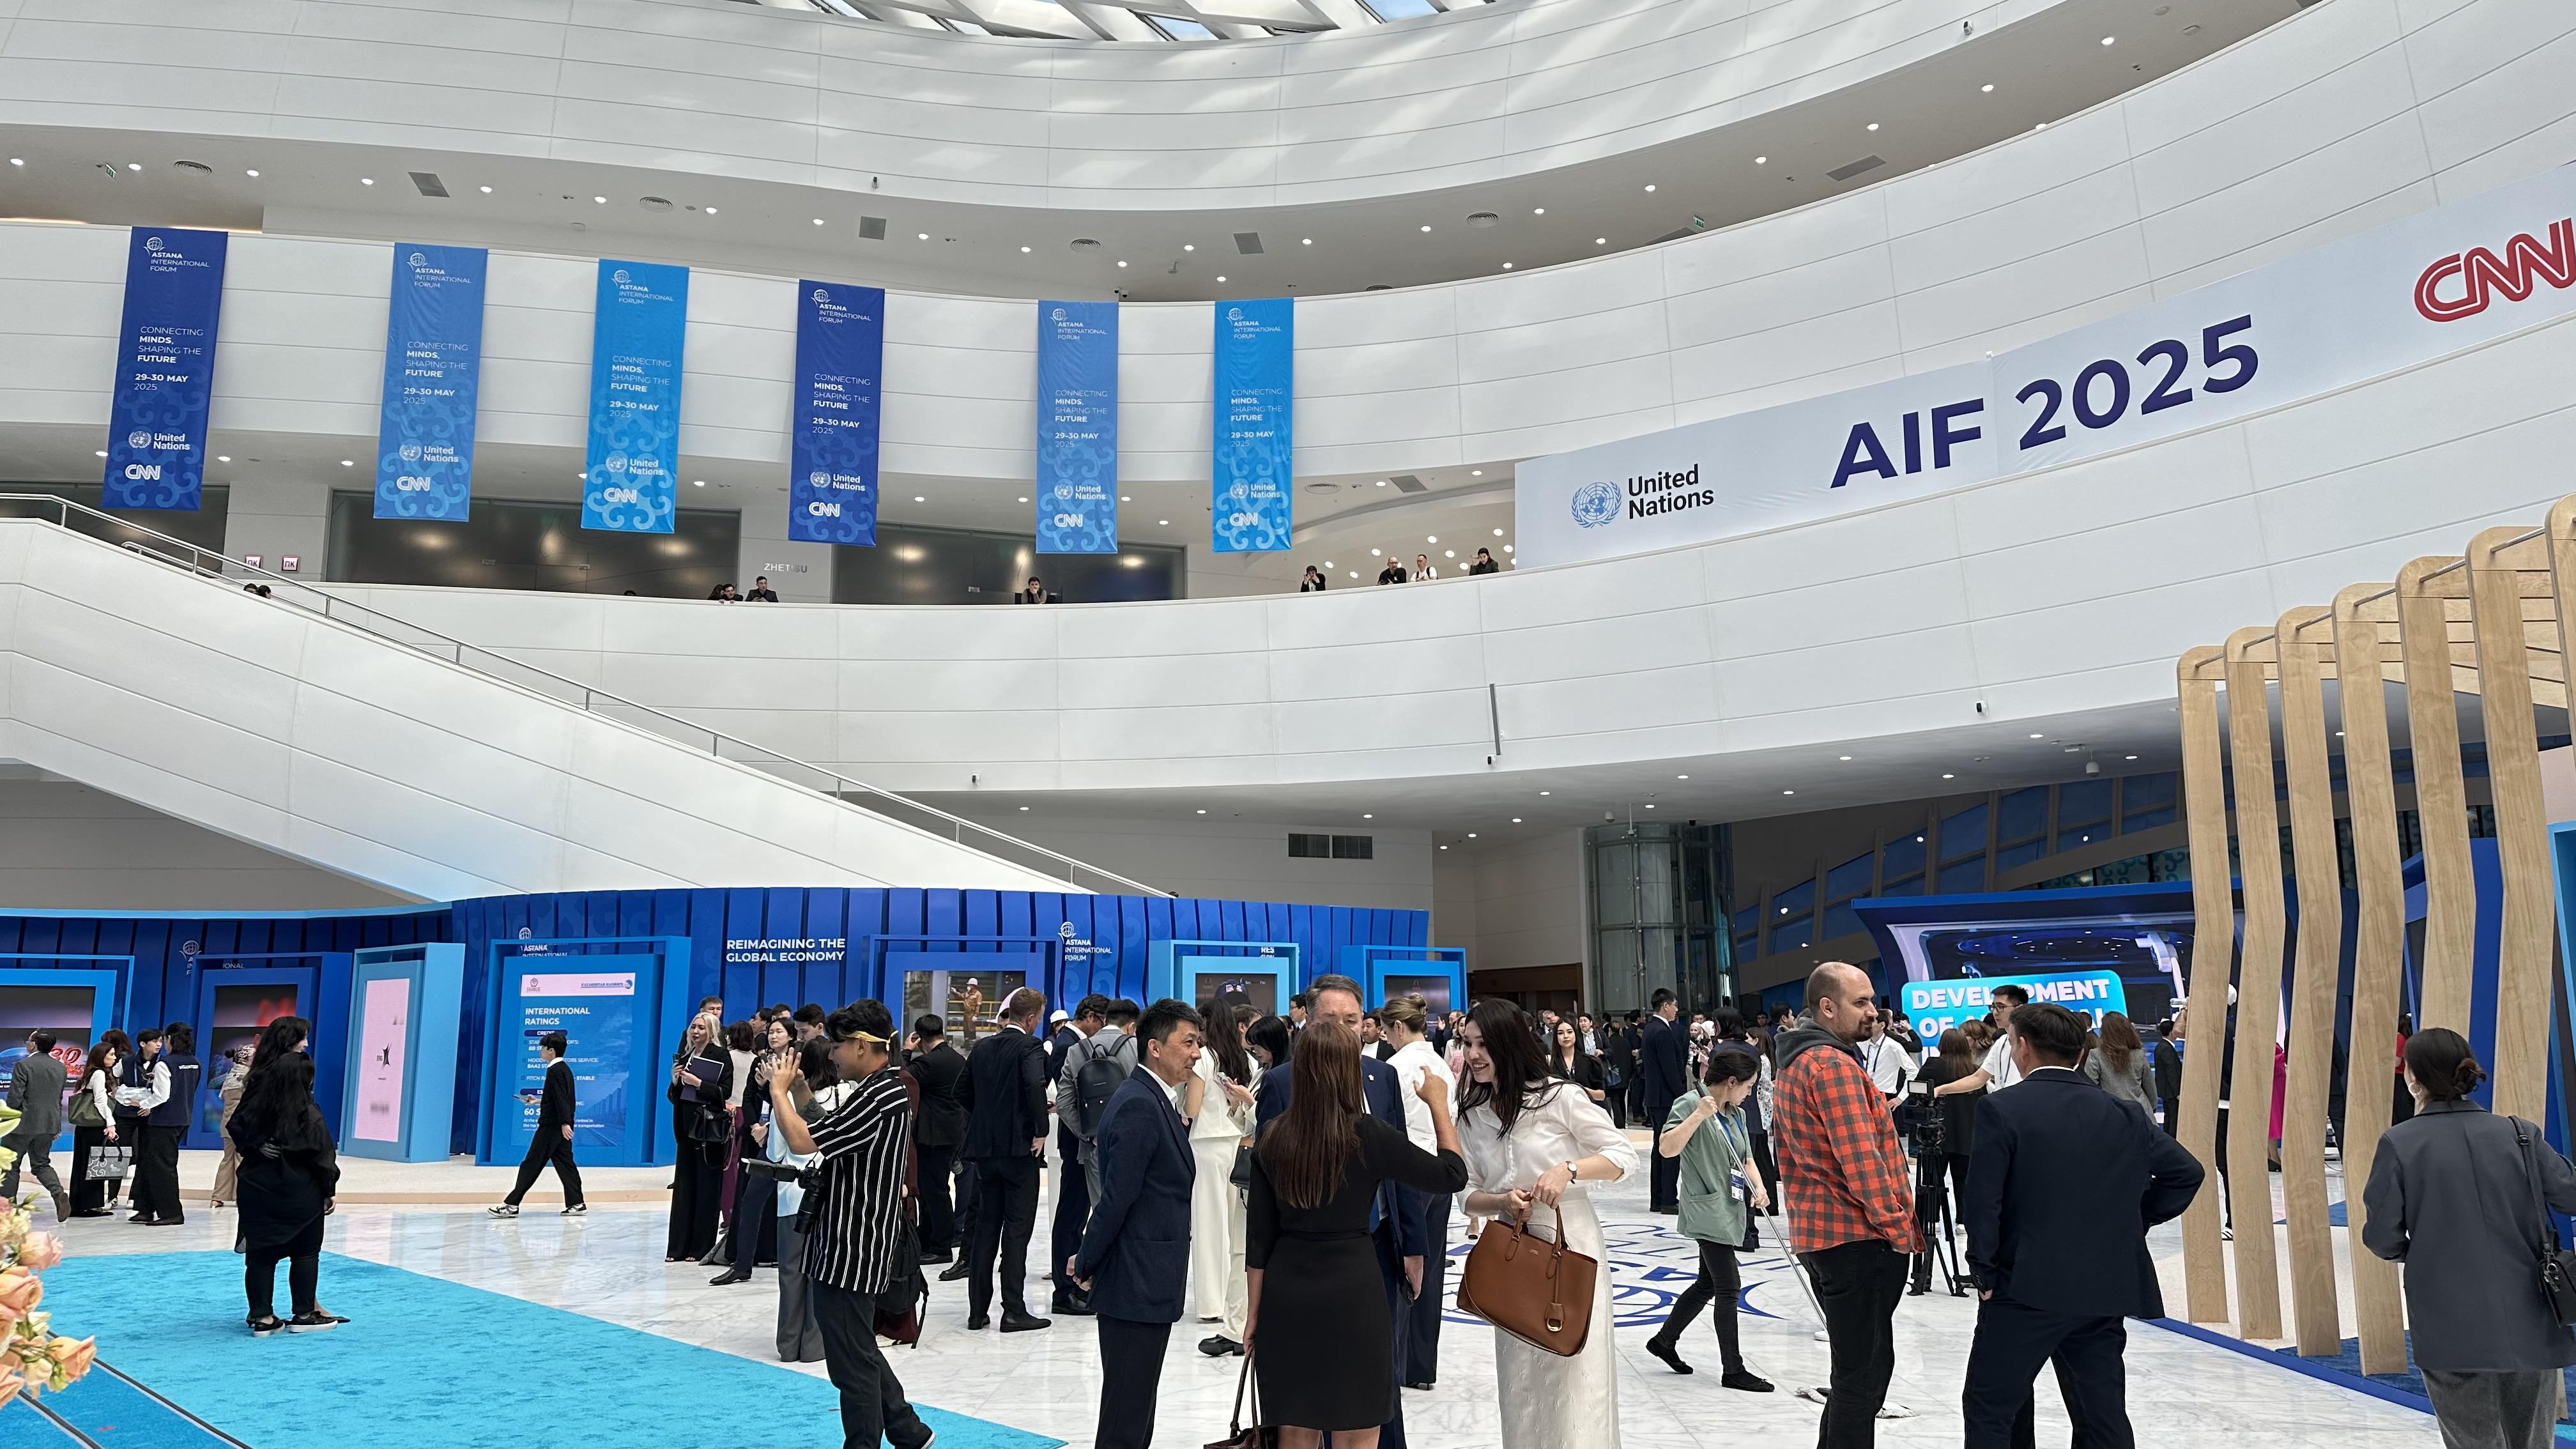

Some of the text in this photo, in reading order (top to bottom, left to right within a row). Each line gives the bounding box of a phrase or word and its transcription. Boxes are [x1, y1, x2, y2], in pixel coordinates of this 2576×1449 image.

[151, 259, 210, 268] INTERNATIONAL
[2414, 217, 2576, 323] CNN
[415, 275, 471, 284] INTERNATIONAL
[619, 291, 674, 302] INTERNATIONAL
[819, 310, 871, 321] INTERNATIONAL
[141, 326, 204, 335] CONNECTING
[138, 345, 181, 354] SHAPING
[407, 342, 468, 351] CONNECTING
[137, 355, 177, 364] FUTURE
[407, 351, 440, 359] MINDS,
[406, 360, 447, 368] SHAPING
[613, 355, 671, 367] CONNECTING
[405, 369, 443, 378] FUTURE
[612, 365, 644, 374] MINDS,
[611, 374, 651, 384] SHAPING
[815, 373, 870, 385] CONNECTING
[611, 383, 648, 392] FUTURE
[815, 383, 845, 392] MINDS,
[814, 391, 852, 401] SHAPING
[813, 400, 848, 410] FUTURE
[1830, 314, 2258, 489] AIF 2025
[640, 403, 659, 411] MAY
[812, 426, 834, 434] 2025
[154, 433, 185, 442] United
[153, 441, 190, 450] Nations
[424, 446, 454, 454] United
[424, 454, 459, 463] Nations
[630, 458, 659, 468] United
[125, 464, 161, 480] CNN
[629, 466, 664, 475] Nations
[396, 476, 431, 491] CNN
[833, 474, 861, 484] United
[1629, 463, 1699, 496] United
[833, 482, 866, 491] Nations
[604, 487, 637, 503] CNN
[1629, 489, 1714, 519] Nations
[808, 502, 840, 518] CNN
[1054, 514, 1084, 527] CNN
[1229, 512, 1258, 526] CNN
[763, 563, 808, 573] ZHETISU
[726, 938, 845, 949] REIMAGINING THE
[726, 951, 845, 962] GLOBAL ECONOMY
[1912, 979, 2110, 1010] DEVELPMENT
